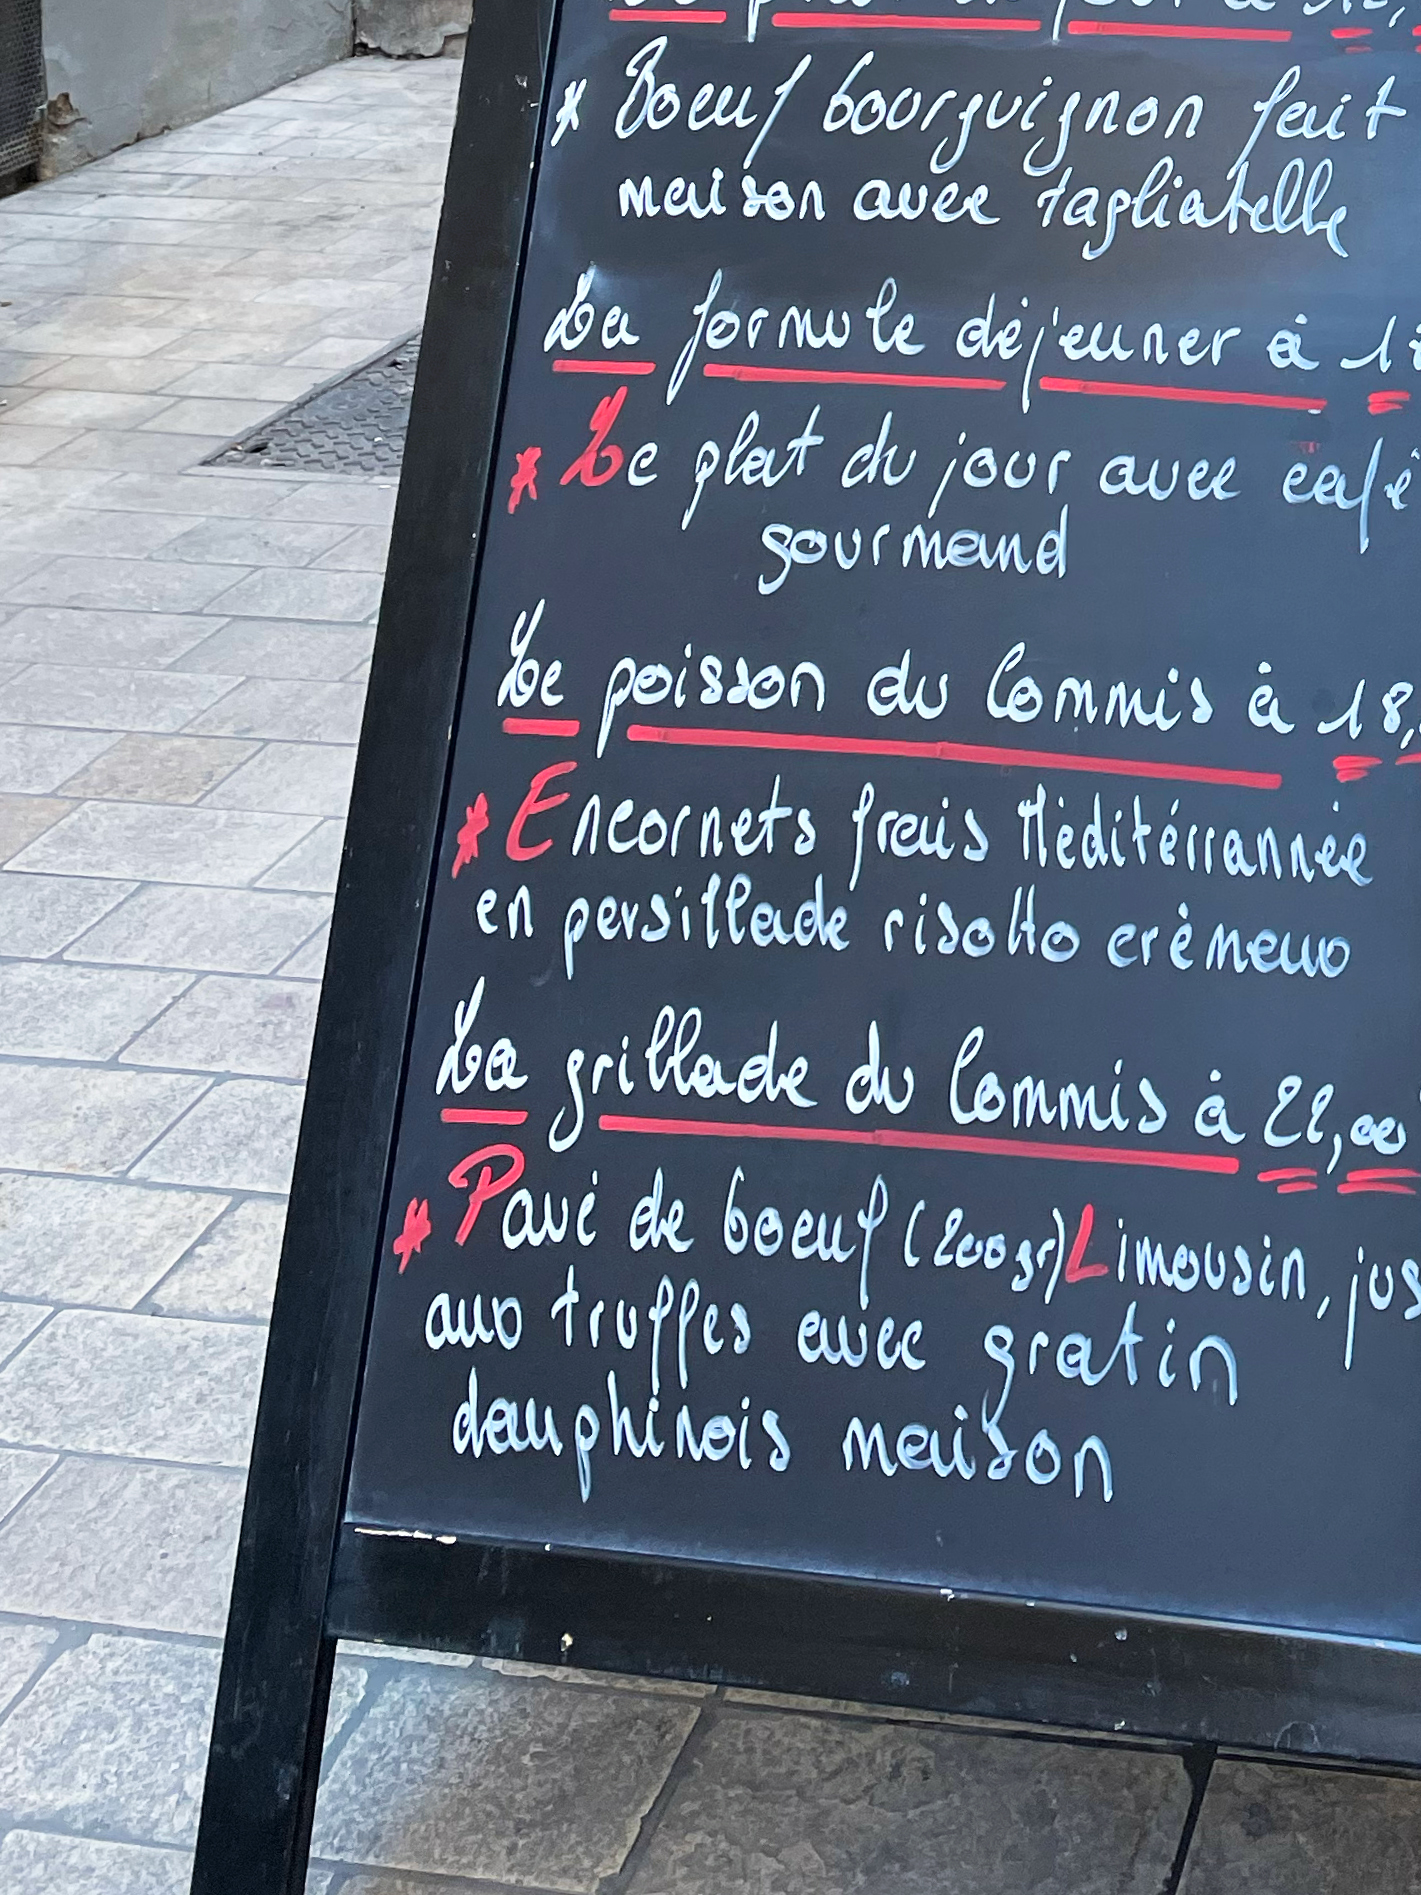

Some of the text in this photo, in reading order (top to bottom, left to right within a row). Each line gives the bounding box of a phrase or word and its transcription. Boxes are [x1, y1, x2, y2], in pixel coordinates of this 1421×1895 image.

[614, 35, 1407, 181] Boeuf bourguignon fait
[618, 167, 826, 221] maison
[853, 179, 1001, 225] avec
[543, 262, 640, 353] La
[666, 268, 925, 406] formule
[956, 292, 1242, 414] déjeuner
[1266, 313, 1320, 372] à
[559, 386, 1421, 555] Le plat du jour avec café
[758, 504, 1069, 595] gourmand
[498, 598, 564, 708] Le
[596, 643, 825, 759] poisson
[866, 648, 949, 720] du
[987, 641, 1213, 732] Commis
[1248, 661, 1295, 735] à
[506, 760, 817, 862] Encornets
[849, 782, 989, 891] frais
[476, 884, 535, 940] en
[563, 872, 851, 981] persillade
[883, 884, 1081, 963] risotto
[435, 976, 529, 1095] La
[547, 1005, 818, 1153] grillade
[844, 1020, 915, 1116] du
[949, 1025, 1168, 1135] Commis
[1193, 1069, 1247, 1146] à
[447, 1143, 598, 1250] Pavé
[628, 1166, 696, 1254] de
[723, 1166, 890, 1311] boeuf
[424, 1264, 1239, 1433] aux truffes avec gratin
[452, 1366, 1114, 1504] dauphinois maison
